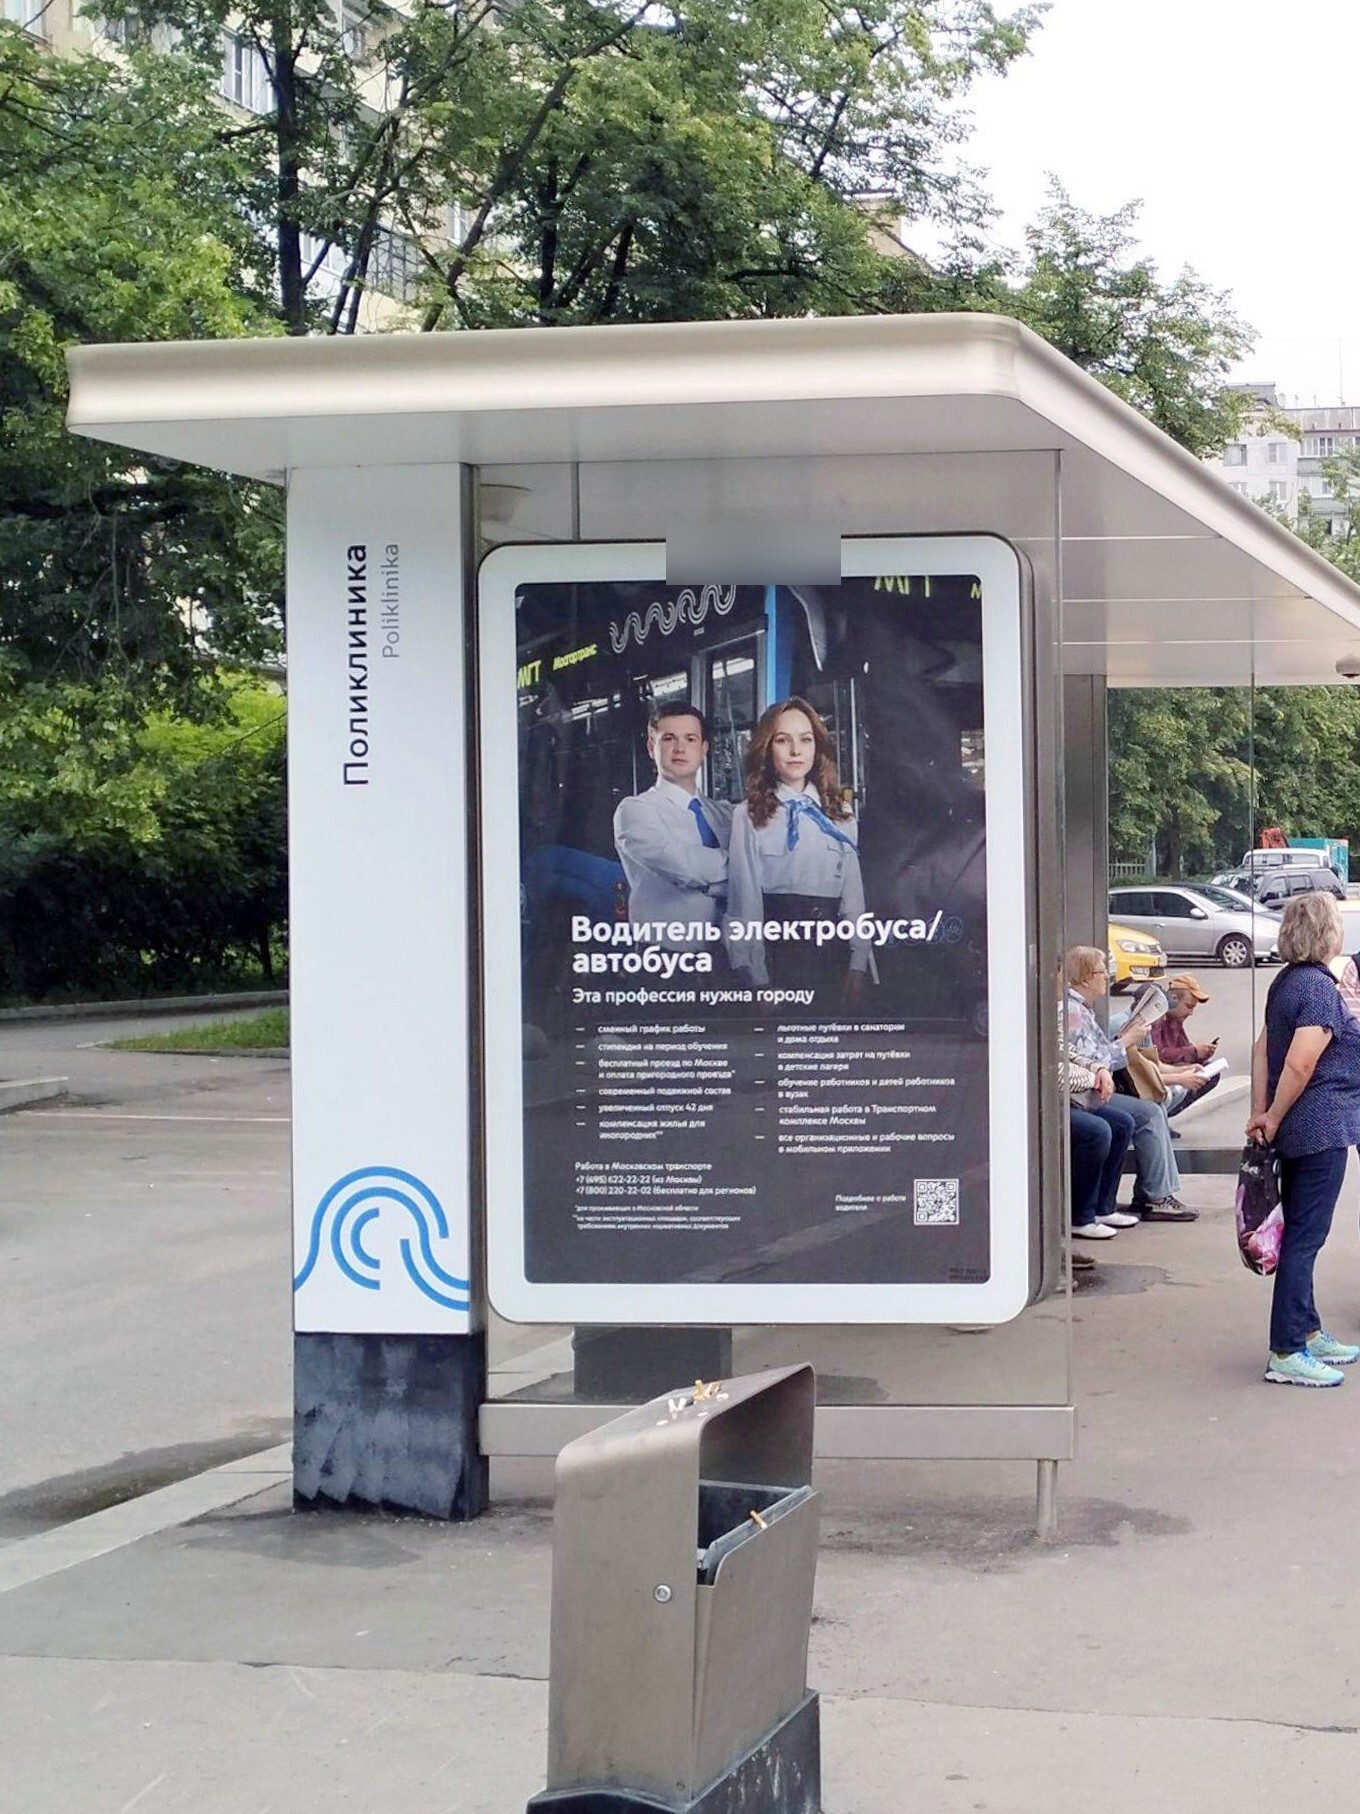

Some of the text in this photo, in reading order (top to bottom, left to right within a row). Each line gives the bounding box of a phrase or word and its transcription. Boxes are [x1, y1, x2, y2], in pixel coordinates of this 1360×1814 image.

[380, 544, 400, 658] Poliklinika
[343, 544, 369, 785] Поликлиника
[572, 910, 943, 946] Водитель электробуса/
[573, 945, 712, 979] автобуса
[572, 988, 815, 1005] Эта профессия нужна городу
